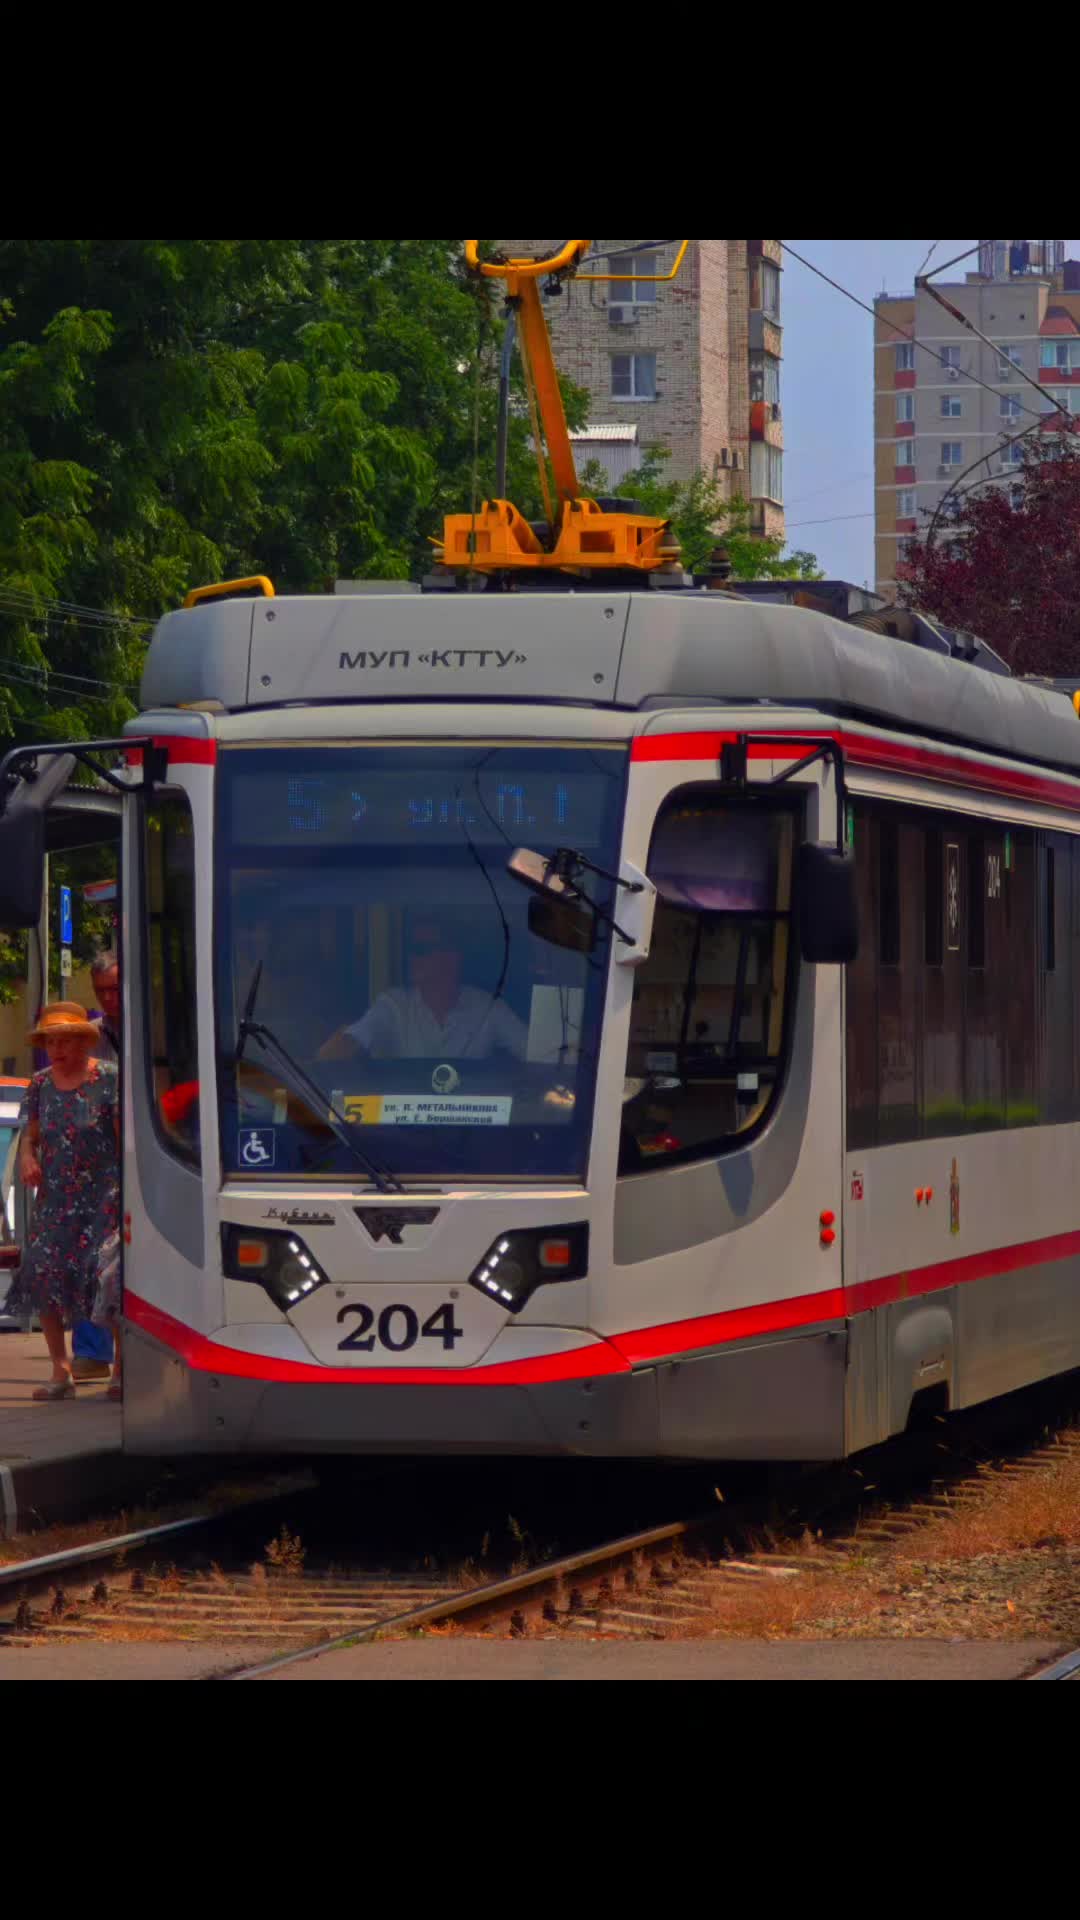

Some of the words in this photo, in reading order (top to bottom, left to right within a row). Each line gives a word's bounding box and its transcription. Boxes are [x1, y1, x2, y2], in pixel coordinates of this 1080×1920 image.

[339, 651, 410, 669] МУП
[418, 650, 527, 668] «КТТУ»
[287, 776, 327, 831] 5
[336, 1302, 463, 1352] 204
